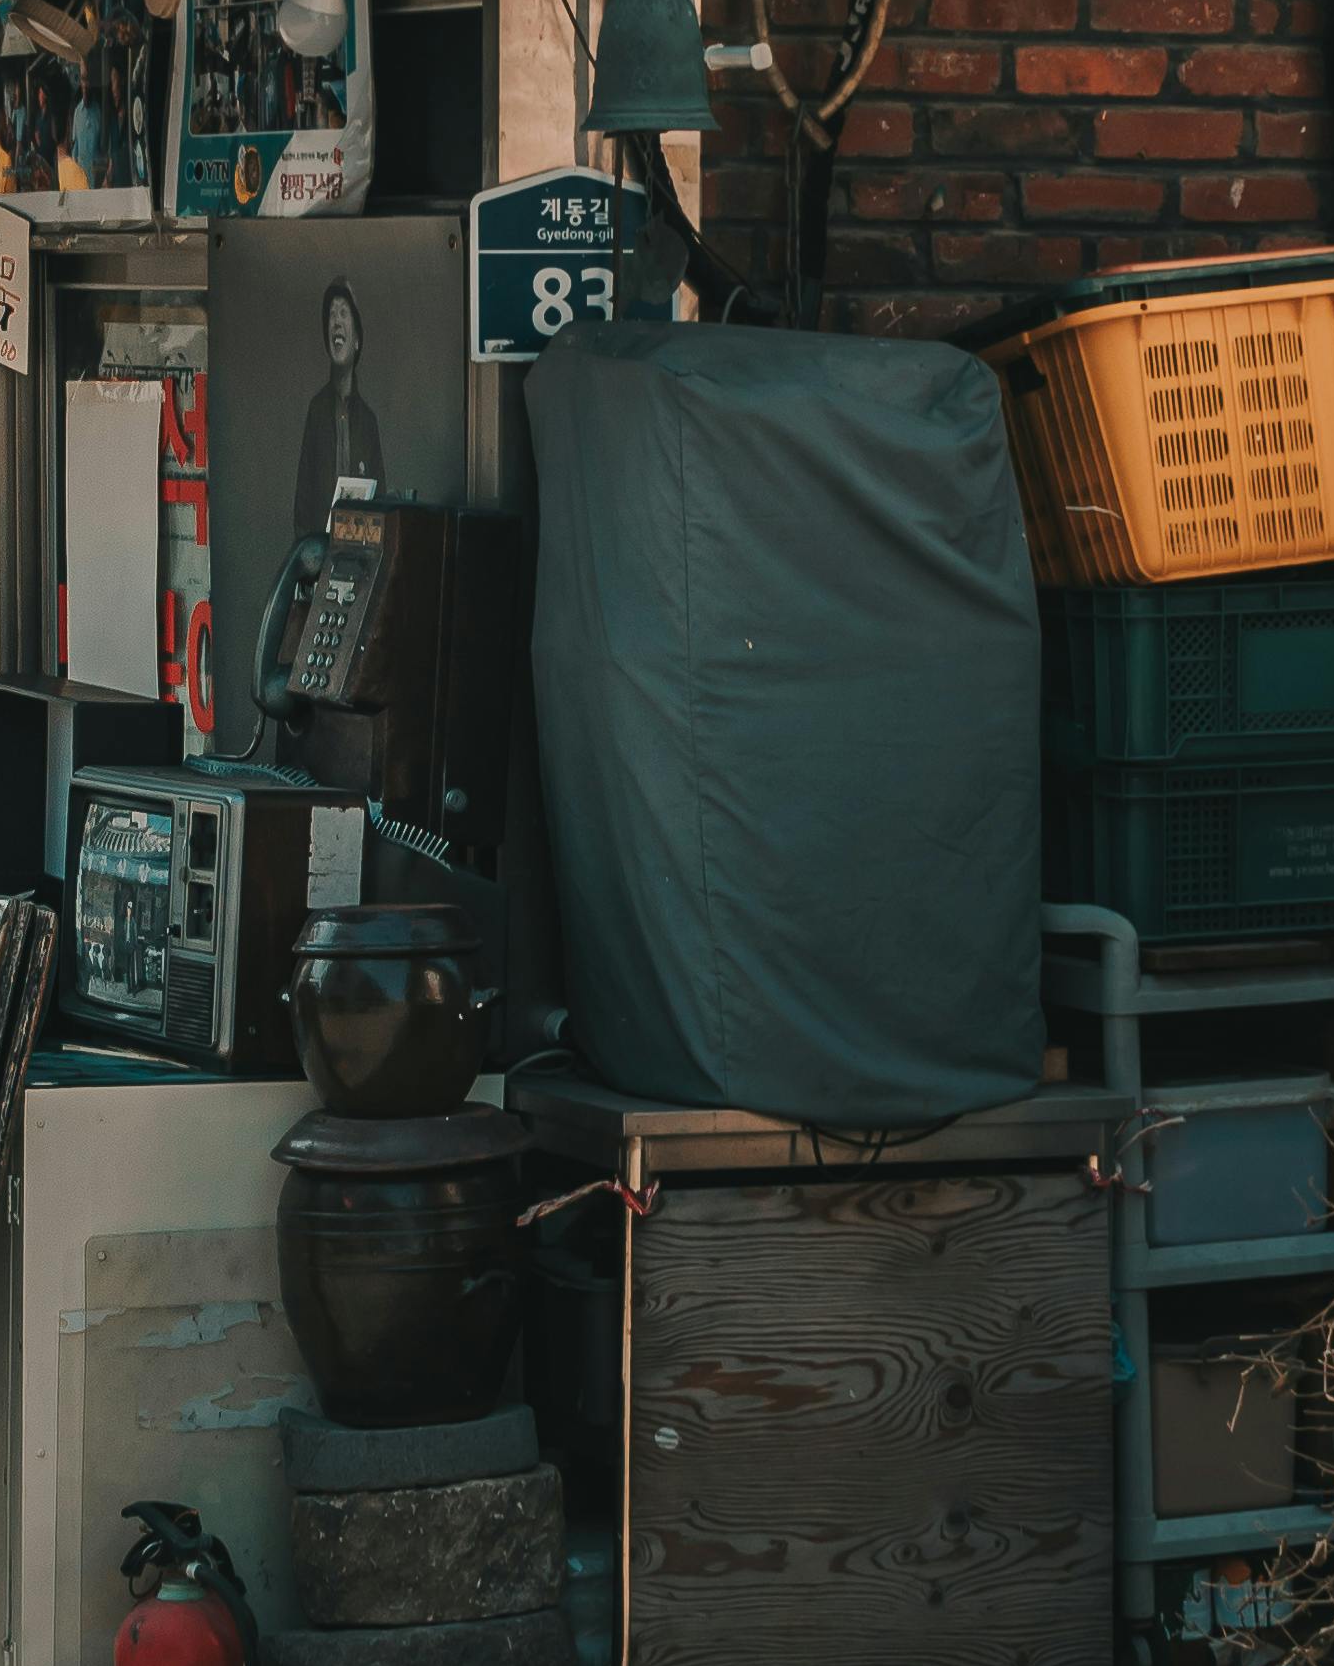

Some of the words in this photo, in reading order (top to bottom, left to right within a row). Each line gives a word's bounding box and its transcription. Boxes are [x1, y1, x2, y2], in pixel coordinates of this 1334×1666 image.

[204, 159, 231, 183] YTN
[540, 196, 611, 227] 계동길
[536, 226, 615, 245] Gyedong-gil
[530, 266, 615, 338] 83
